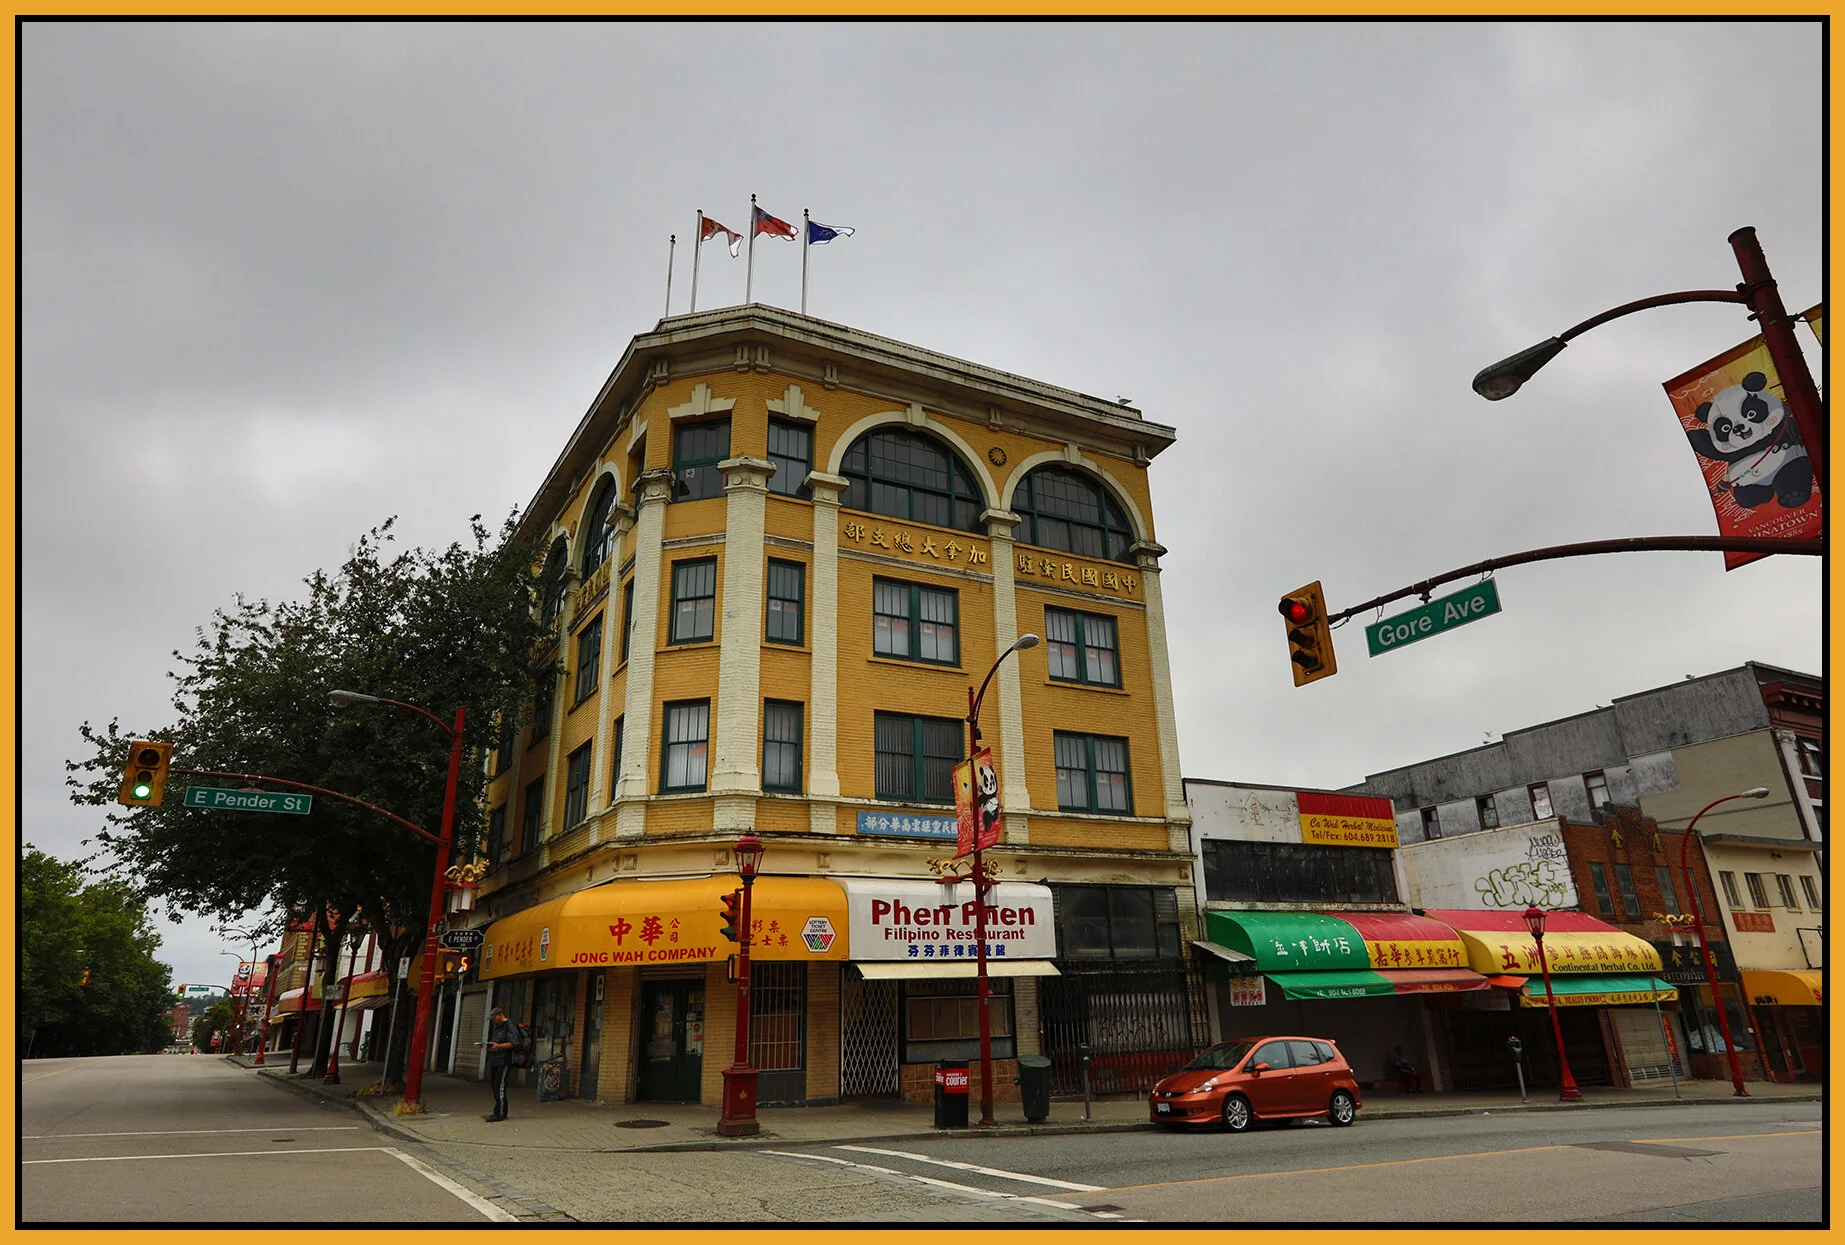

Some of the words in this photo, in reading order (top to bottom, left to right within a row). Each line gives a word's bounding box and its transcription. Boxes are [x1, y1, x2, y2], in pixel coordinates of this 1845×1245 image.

[1748, 508, 1806, 534] VANCOUVER
[1749, 510, 1819, 537] INATOWN
[1378, 615, 1433, 646] Gore
[1443, 595, 1486, 625] Ave
[194, 790, 208, 804] E
[214, 792, 277, 808] Pender
[283, 797, 303, 810] St
[1309, 817, 1321, 828] Ca
[1322, 818, 1340, 829] Wah
[1340, 820, 1363, 831] Herbal
[1365, 821, 1394, 833] Medicine
[871, 899, 951, 926] Phen
[962, 900, 1035, 926] Phen
[453, 935, 473, 943] PENDER
[608, 915, 665, 947] 中華
[669, 917, 681, 944] 公司
[884, 927, 940, 943] Filipino
[946, 927, 1026, 941] Resturant
[461, 956, 468, 971] 5
[571, 951, 608, 964] JONG
[612, 950, 644, 963] WAH
[648, 946, 717, 962] COMPANY
[1552, 963, 1599, 972] Continental
[1600, 963, 1626, 972] Herbal
[1628, 963, 1640, 971] Co.
[1641, 962, 1657, 971] Ltd.
